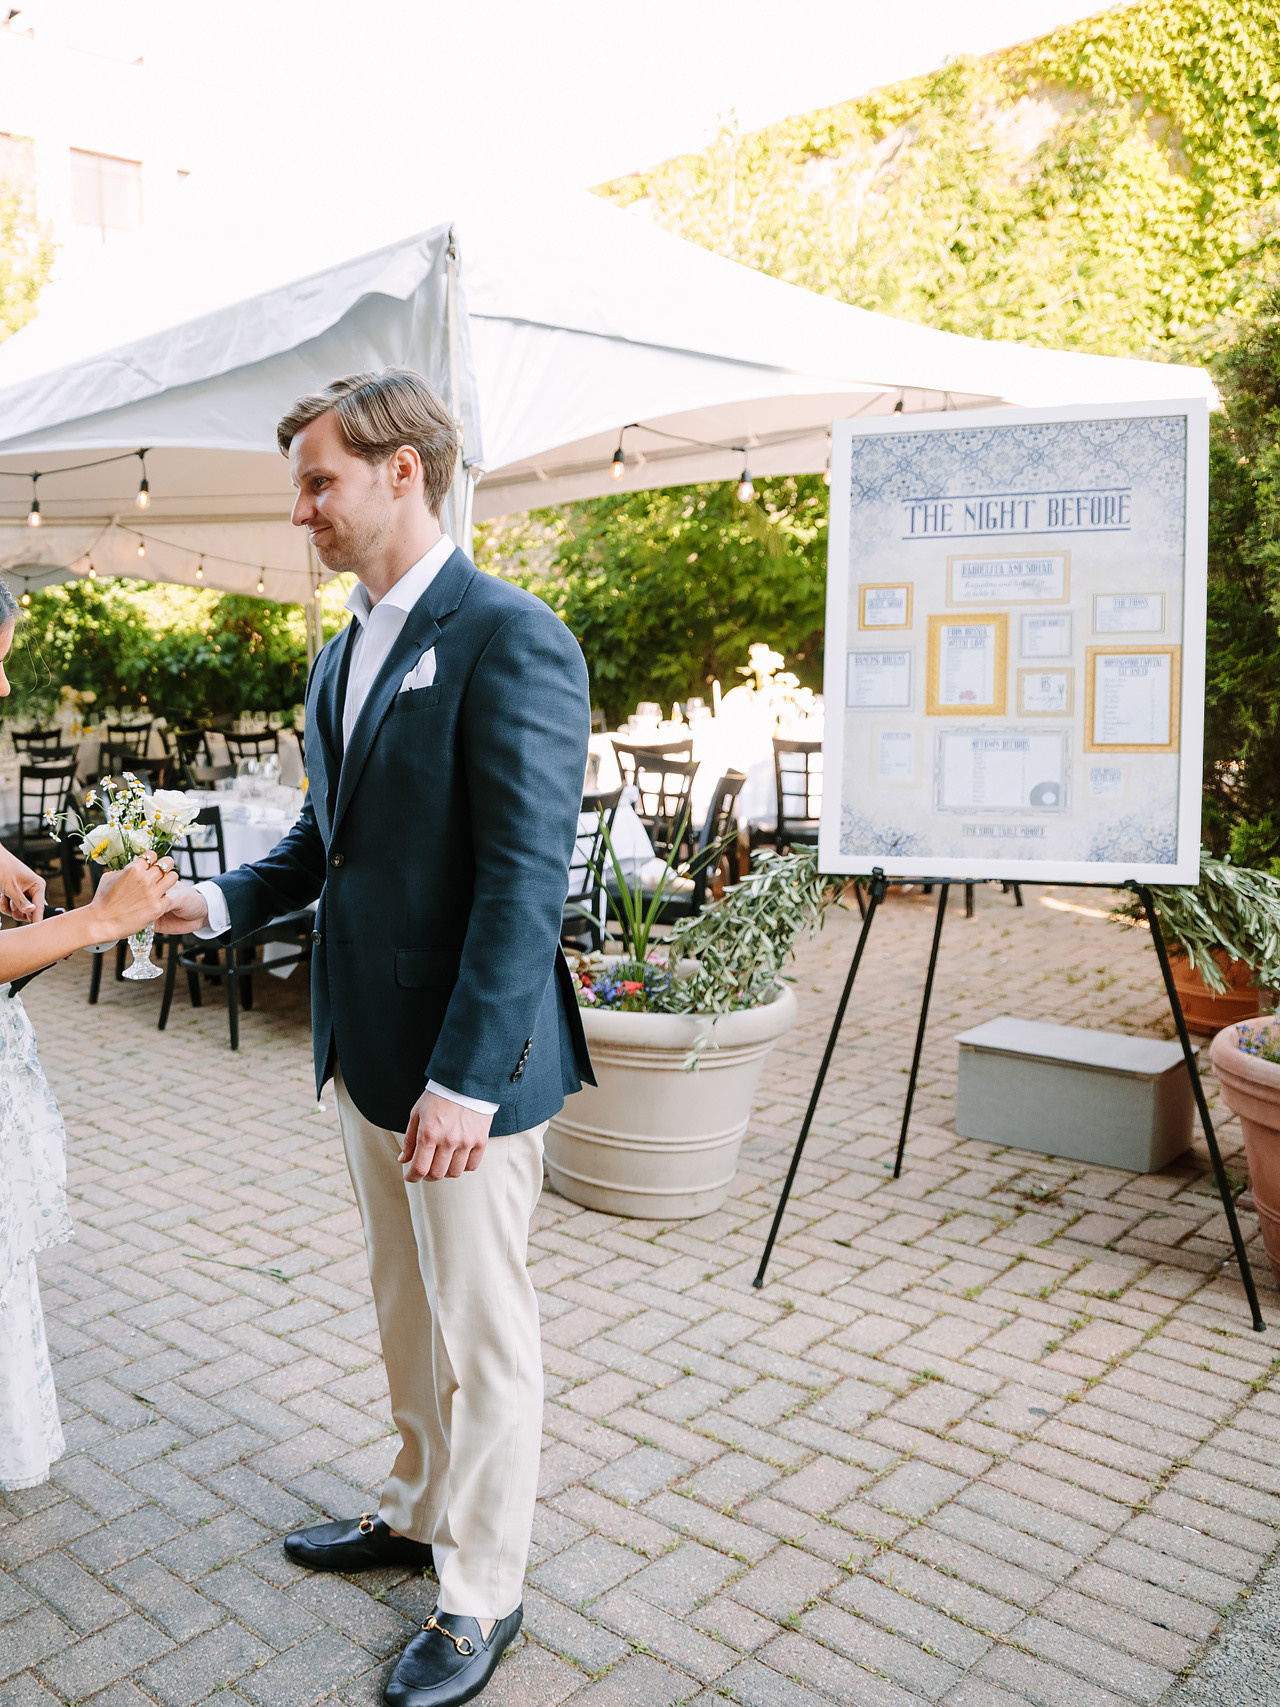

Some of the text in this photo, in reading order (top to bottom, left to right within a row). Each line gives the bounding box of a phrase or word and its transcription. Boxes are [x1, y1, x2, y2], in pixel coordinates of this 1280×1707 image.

[904, 494, 1132, 534] THE NIGHT BEFORE
